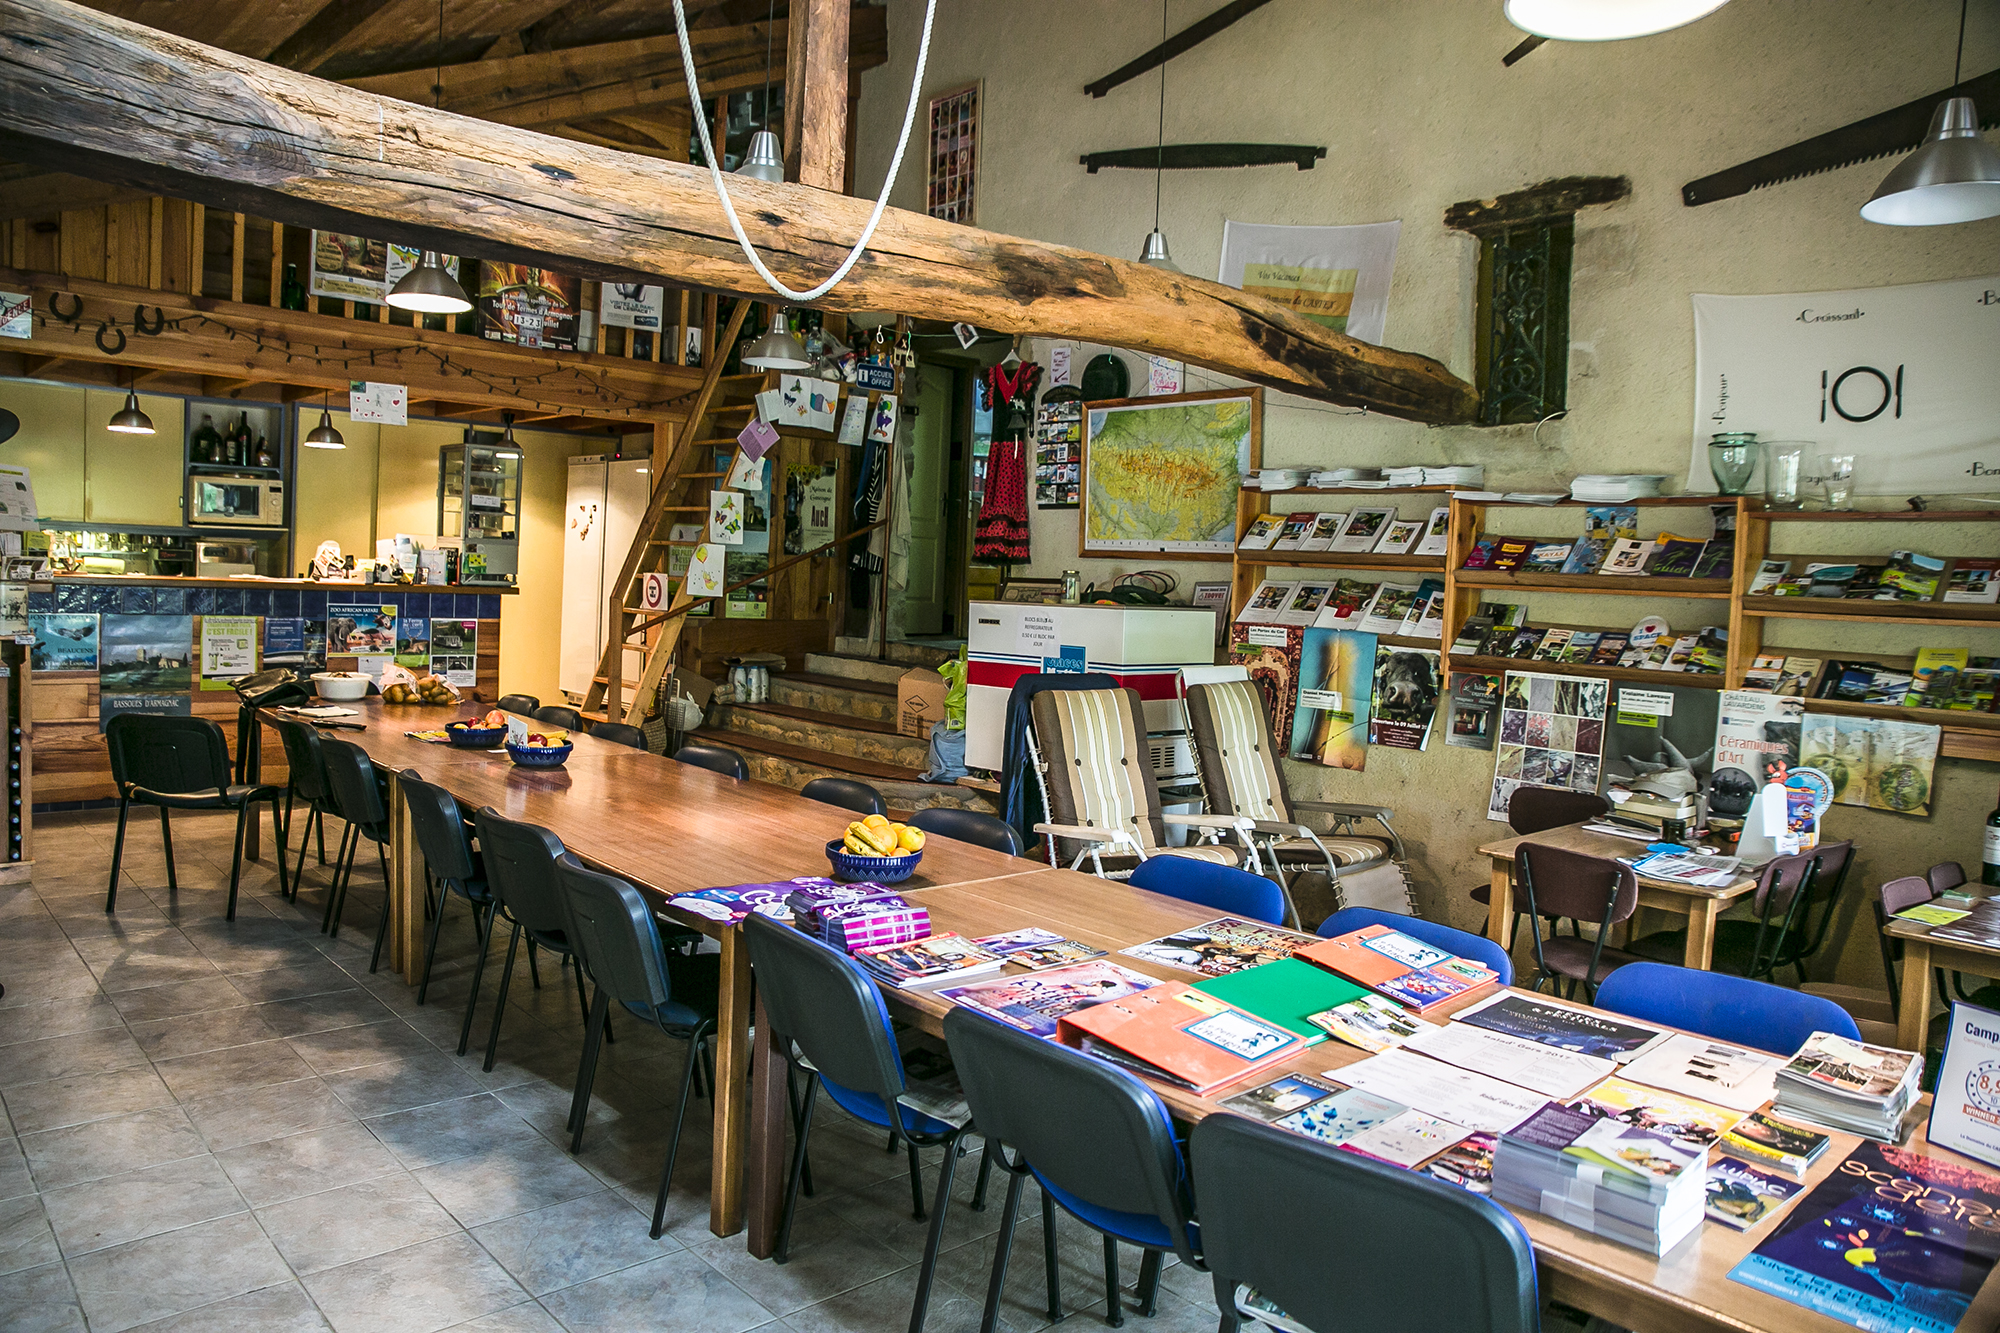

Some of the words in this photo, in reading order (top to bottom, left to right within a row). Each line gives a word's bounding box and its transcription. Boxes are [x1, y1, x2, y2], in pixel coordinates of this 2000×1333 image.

[1258, 270, 1271, 280] Vos
[1272, 271, 1301, 283] Vacances
[1265, 293, 1292, 305] Domaine
[1302, 299, 1336, 310] CASTEX
[517, 304, 538, 315] Termes
[1801, 307, 1861, 324] Croissant
[543, 319, 560, 329] uillet
[868, 369, 894, 380] ACCUEIL
[870, 378, 892, 388] OFFICE
[1652, 563, 1690, 574] Guide
[226, 628, 249, 636] FACILE
[1633, 631, 1662, 641] SPACE
[113, 699, 142, 709] BASSOUES
[1723, 701, 1766, 711] LAVARDENS
[1371, 718, 1394, 726] Ouverture
[1718, 735, 1790, 755] Céramiques
[1717, 750, 1745, 765] d'Art
[1965, 1021, 2000, 1044] Camp
[1543, 1051, 1573, 1061] 2017
[1965, 1105, 1996, 1123] WINNER
[1717, 1162, 1788, 1196] LUPIAC
